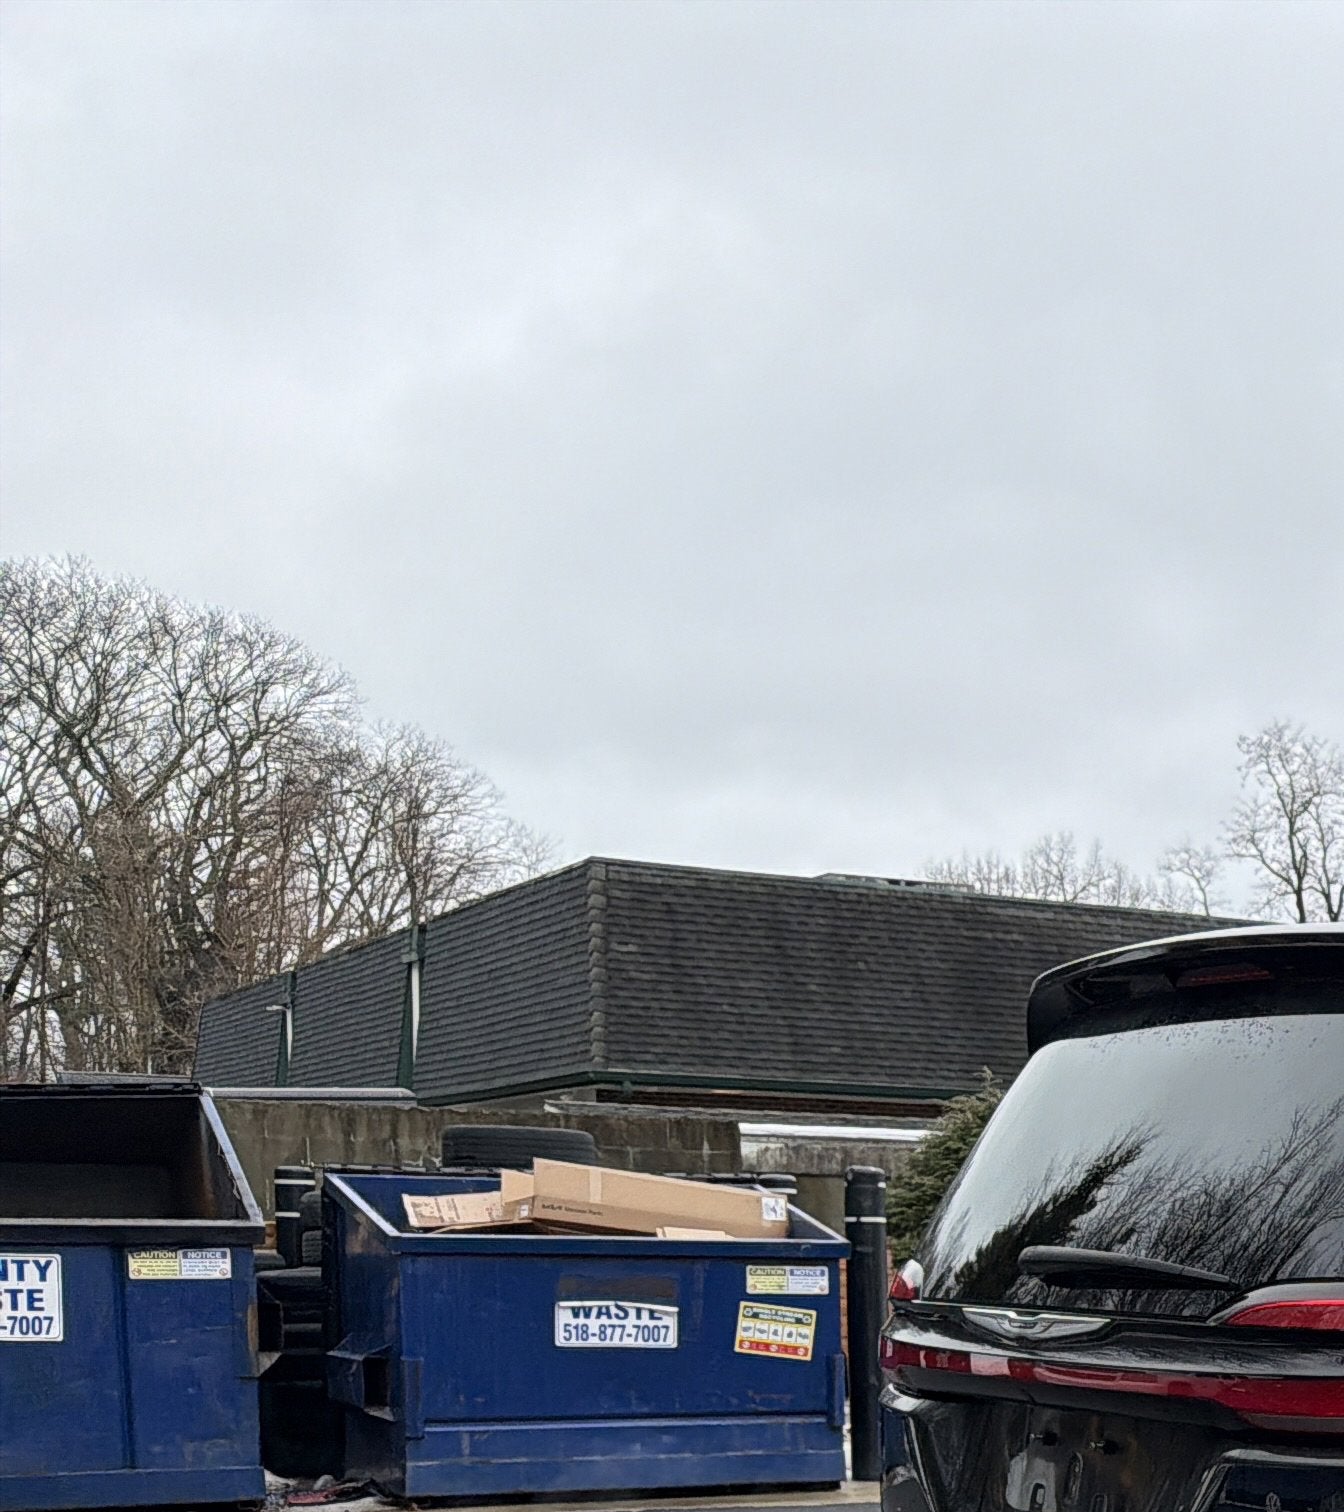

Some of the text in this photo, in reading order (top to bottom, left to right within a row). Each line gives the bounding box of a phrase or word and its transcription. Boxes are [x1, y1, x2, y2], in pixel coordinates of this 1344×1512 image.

[133, 1250, 176, 1259] CAUTION
[187, 1251, 222, 1259] NOTICE
[0, 1288, 45, 1312] TE
[563, 1323, 670, 1343] 518-877-7007
